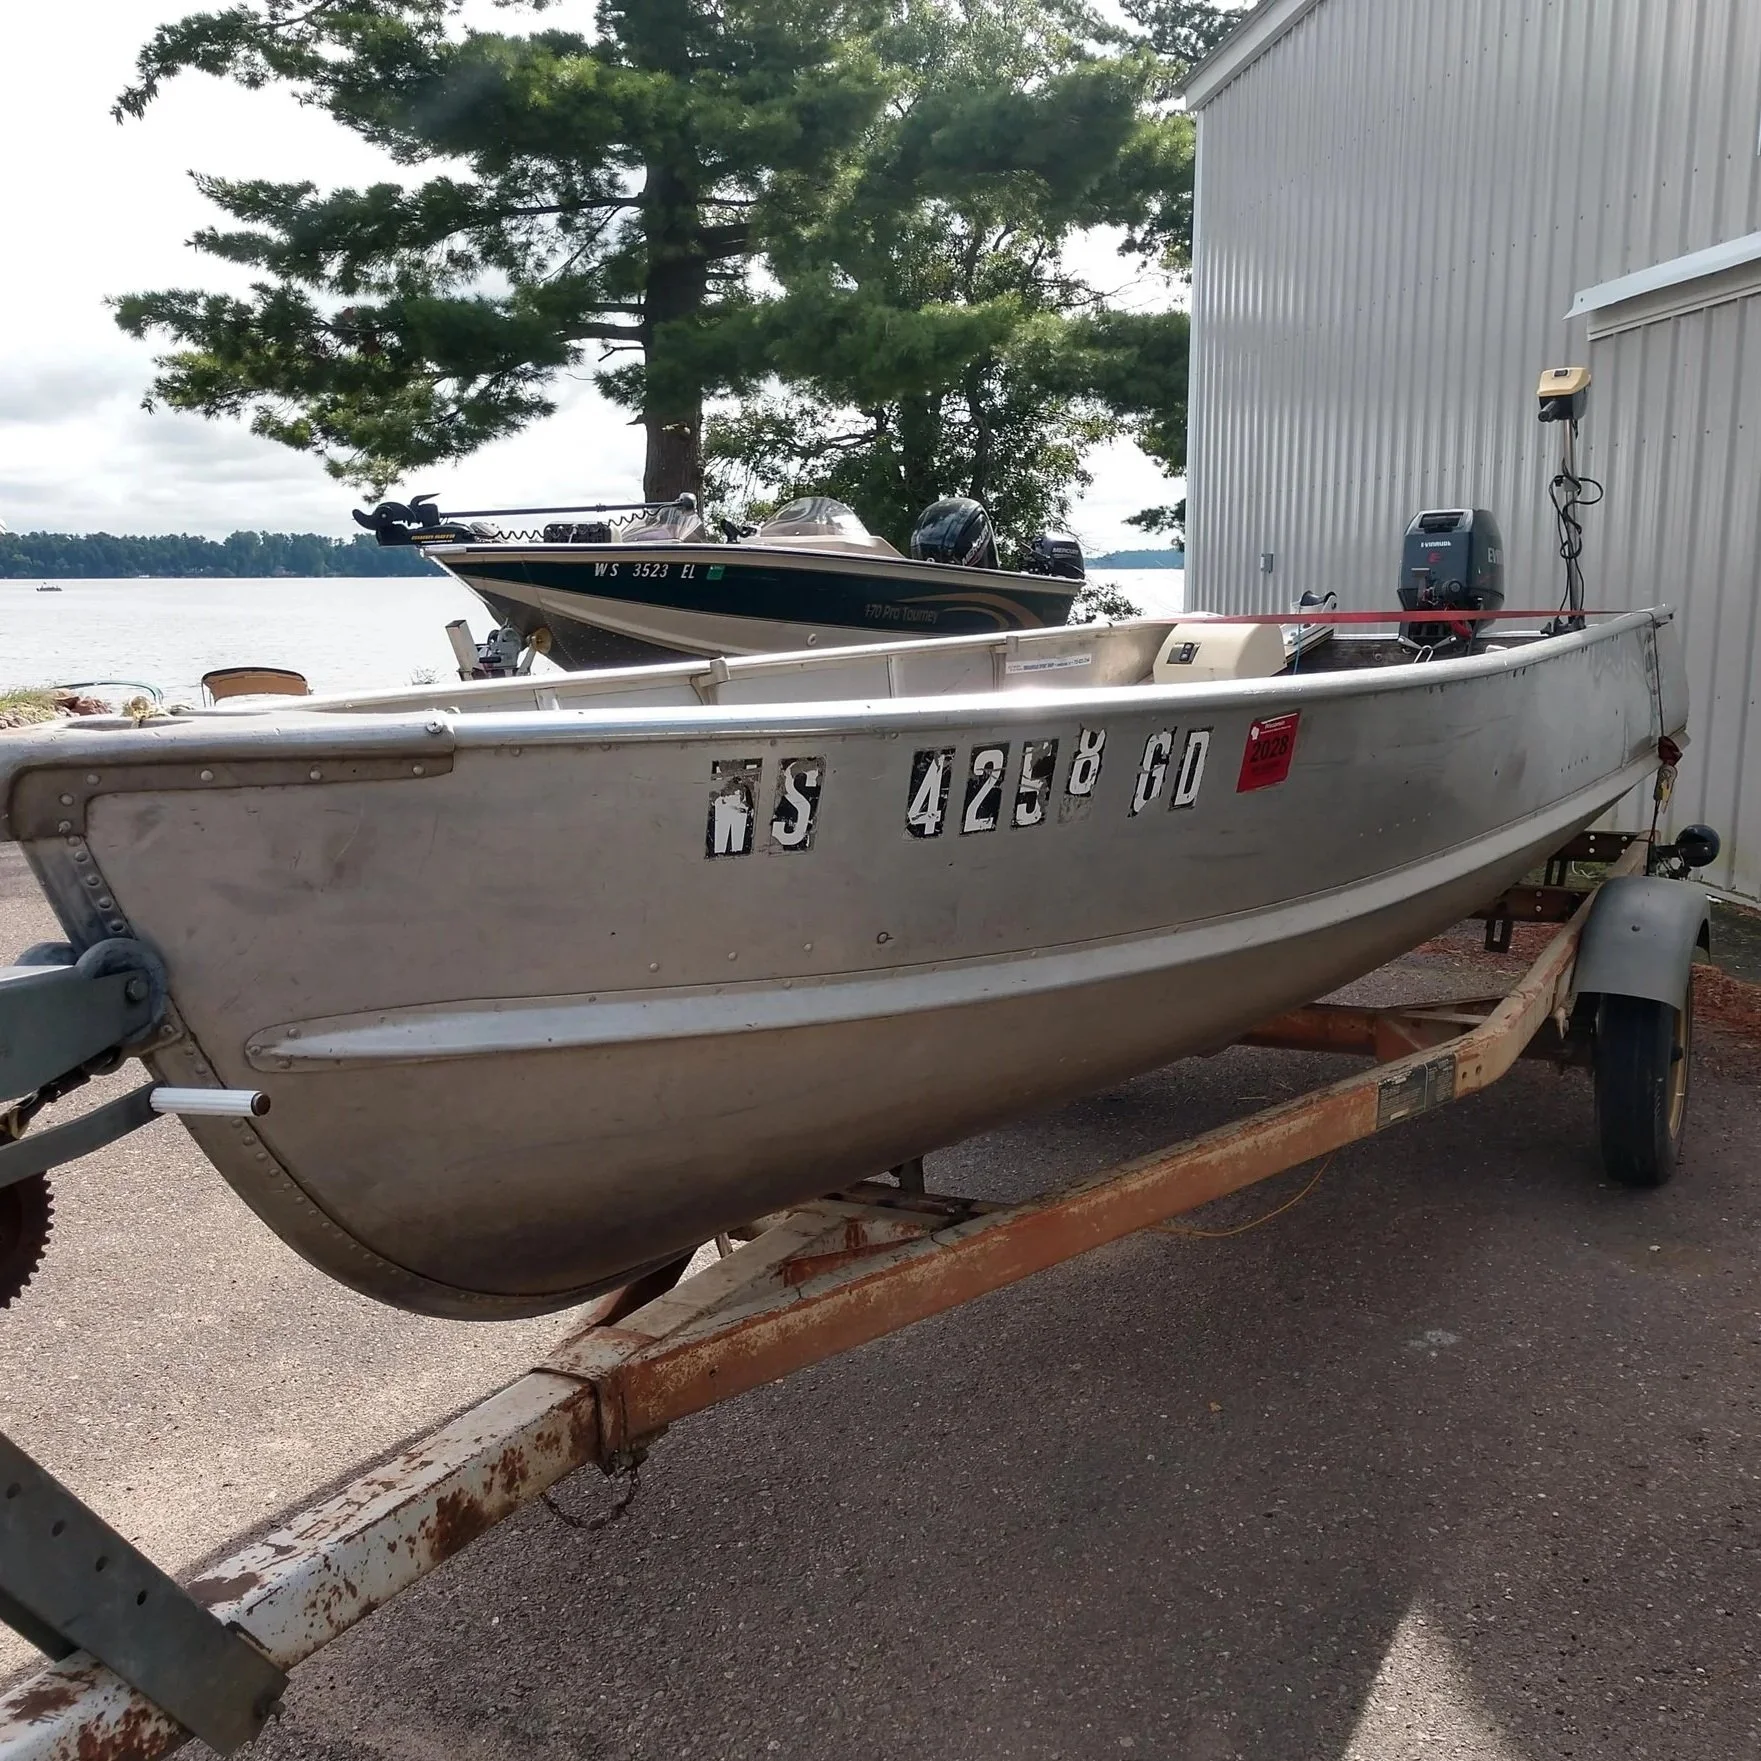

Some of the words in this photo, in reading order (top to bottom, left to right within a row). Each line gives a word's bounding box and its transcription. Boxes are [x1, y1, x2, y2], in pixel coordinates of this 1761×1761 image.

[594, 562, 619, 577] WS
[632, 563, 669, 578] 3523
[680, 564, 695, 579] EL
[882, 605, 900, 620] Pro
[901, 606, 937, 624] Tourney
[1250, 735, 1290, 762] 2028
[708, 758, 822, 857] WS
[905, 729, 1107, 836] 4258
[1130, 729, 1211, 814] GD
